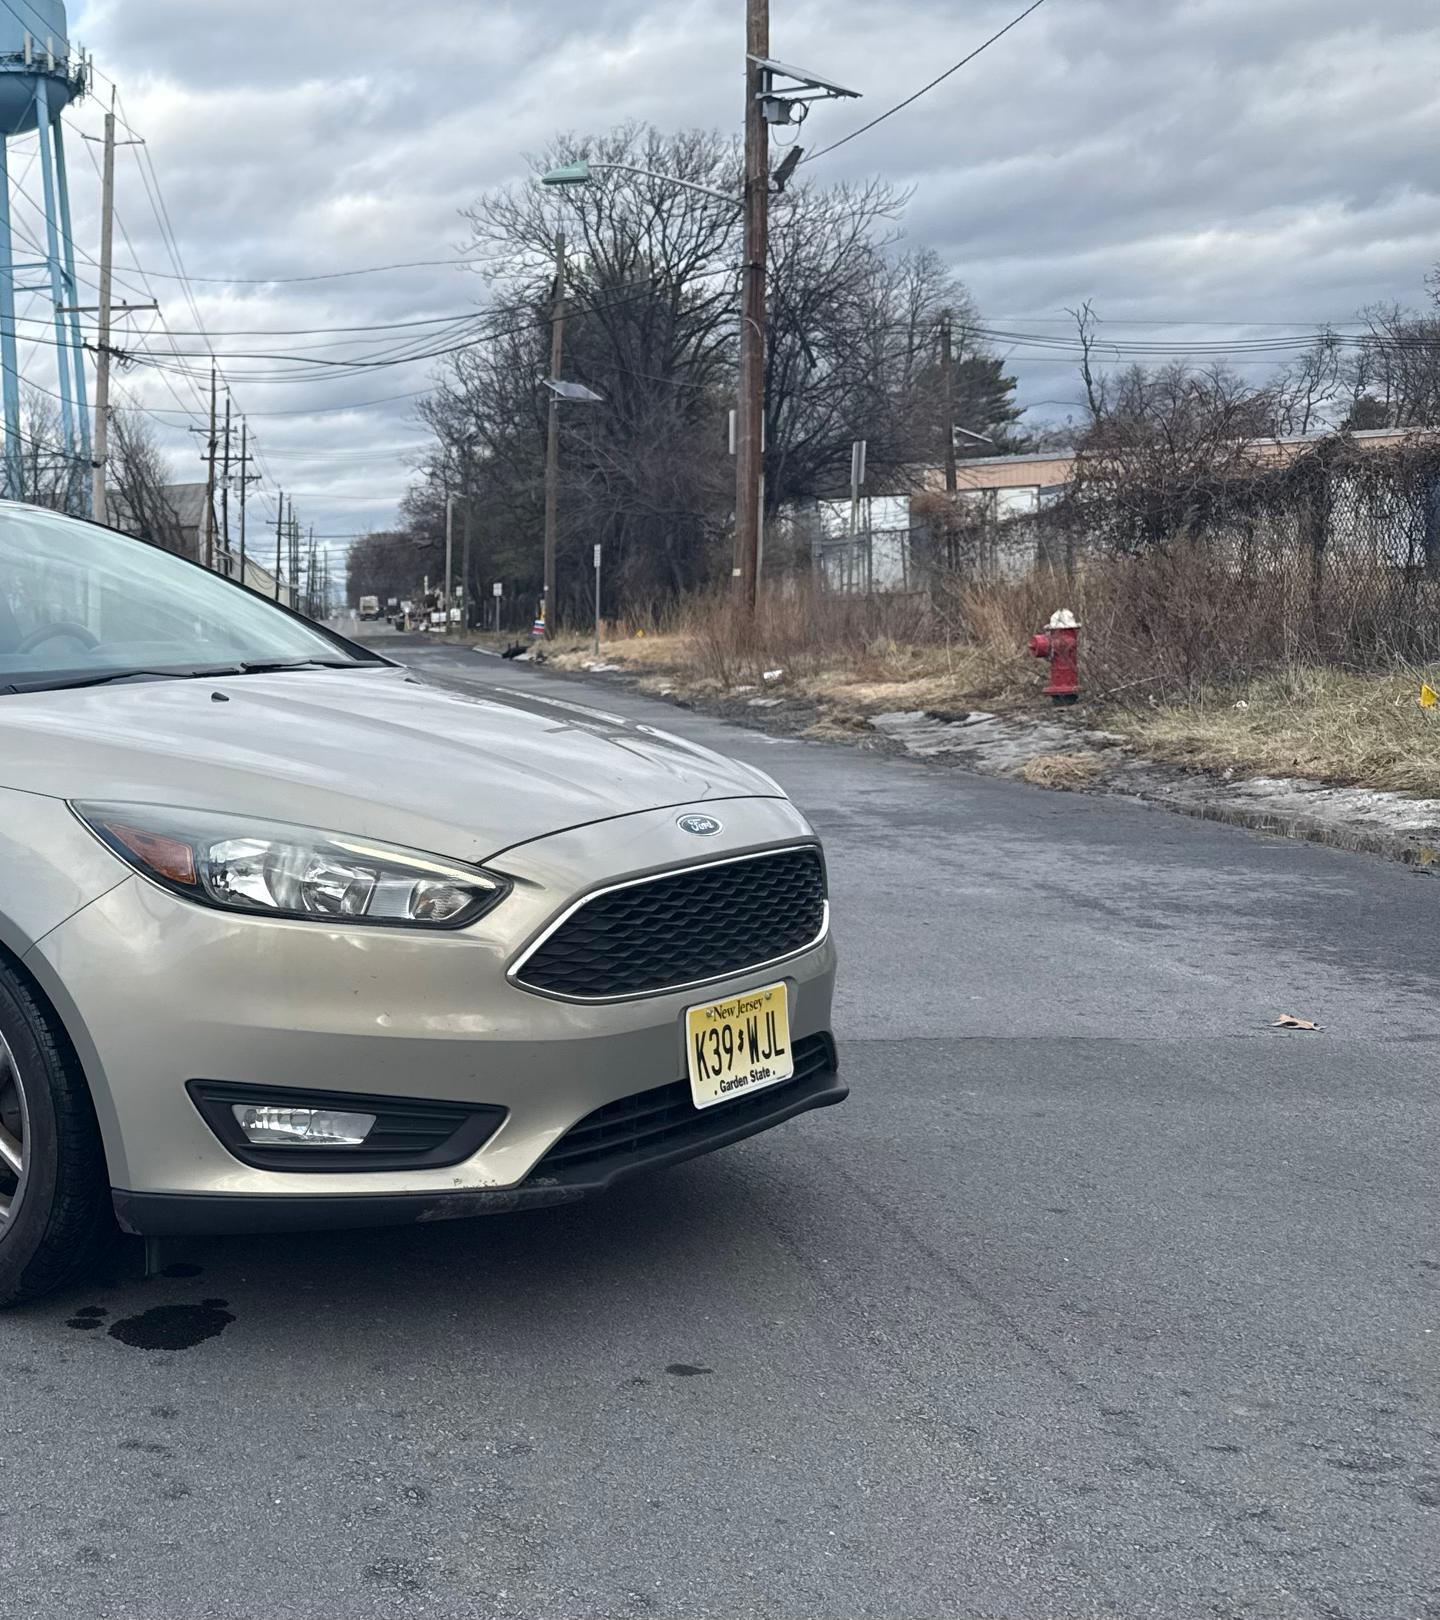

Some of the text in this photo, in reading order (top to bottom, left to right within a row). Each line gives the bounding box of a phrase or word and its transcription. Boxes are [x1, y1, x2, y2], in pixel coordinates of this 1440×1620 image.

[713, 998, 764, 1021] New Jersey
[695, 1010, 785, 1081] K39 WJL
[719, 1066, 771, 1093] Garden State
